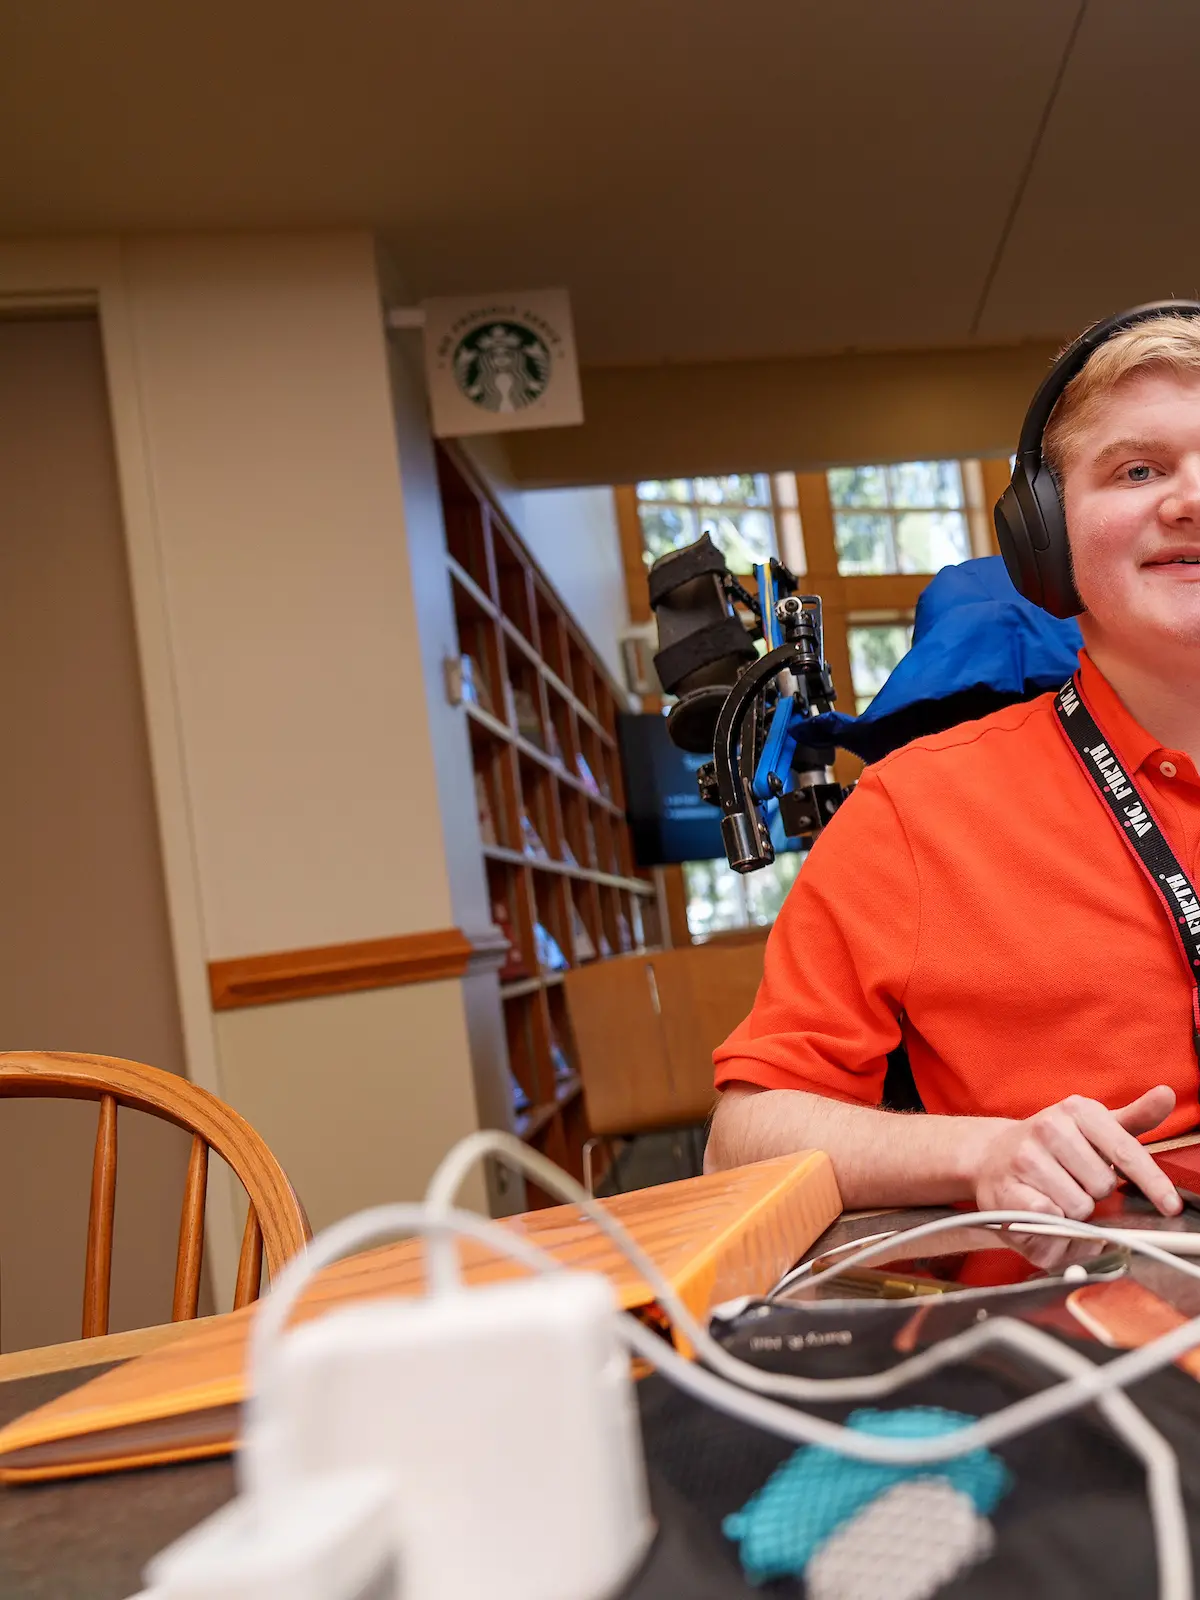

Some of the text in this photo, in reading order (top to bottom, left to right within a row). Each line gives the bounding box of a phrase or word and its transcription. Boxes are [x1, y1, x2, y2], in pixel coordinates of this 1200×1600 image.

[1058, 688, 1080, 717] VIC
[1088, 743, 1153, 838] VIC FIRTH
